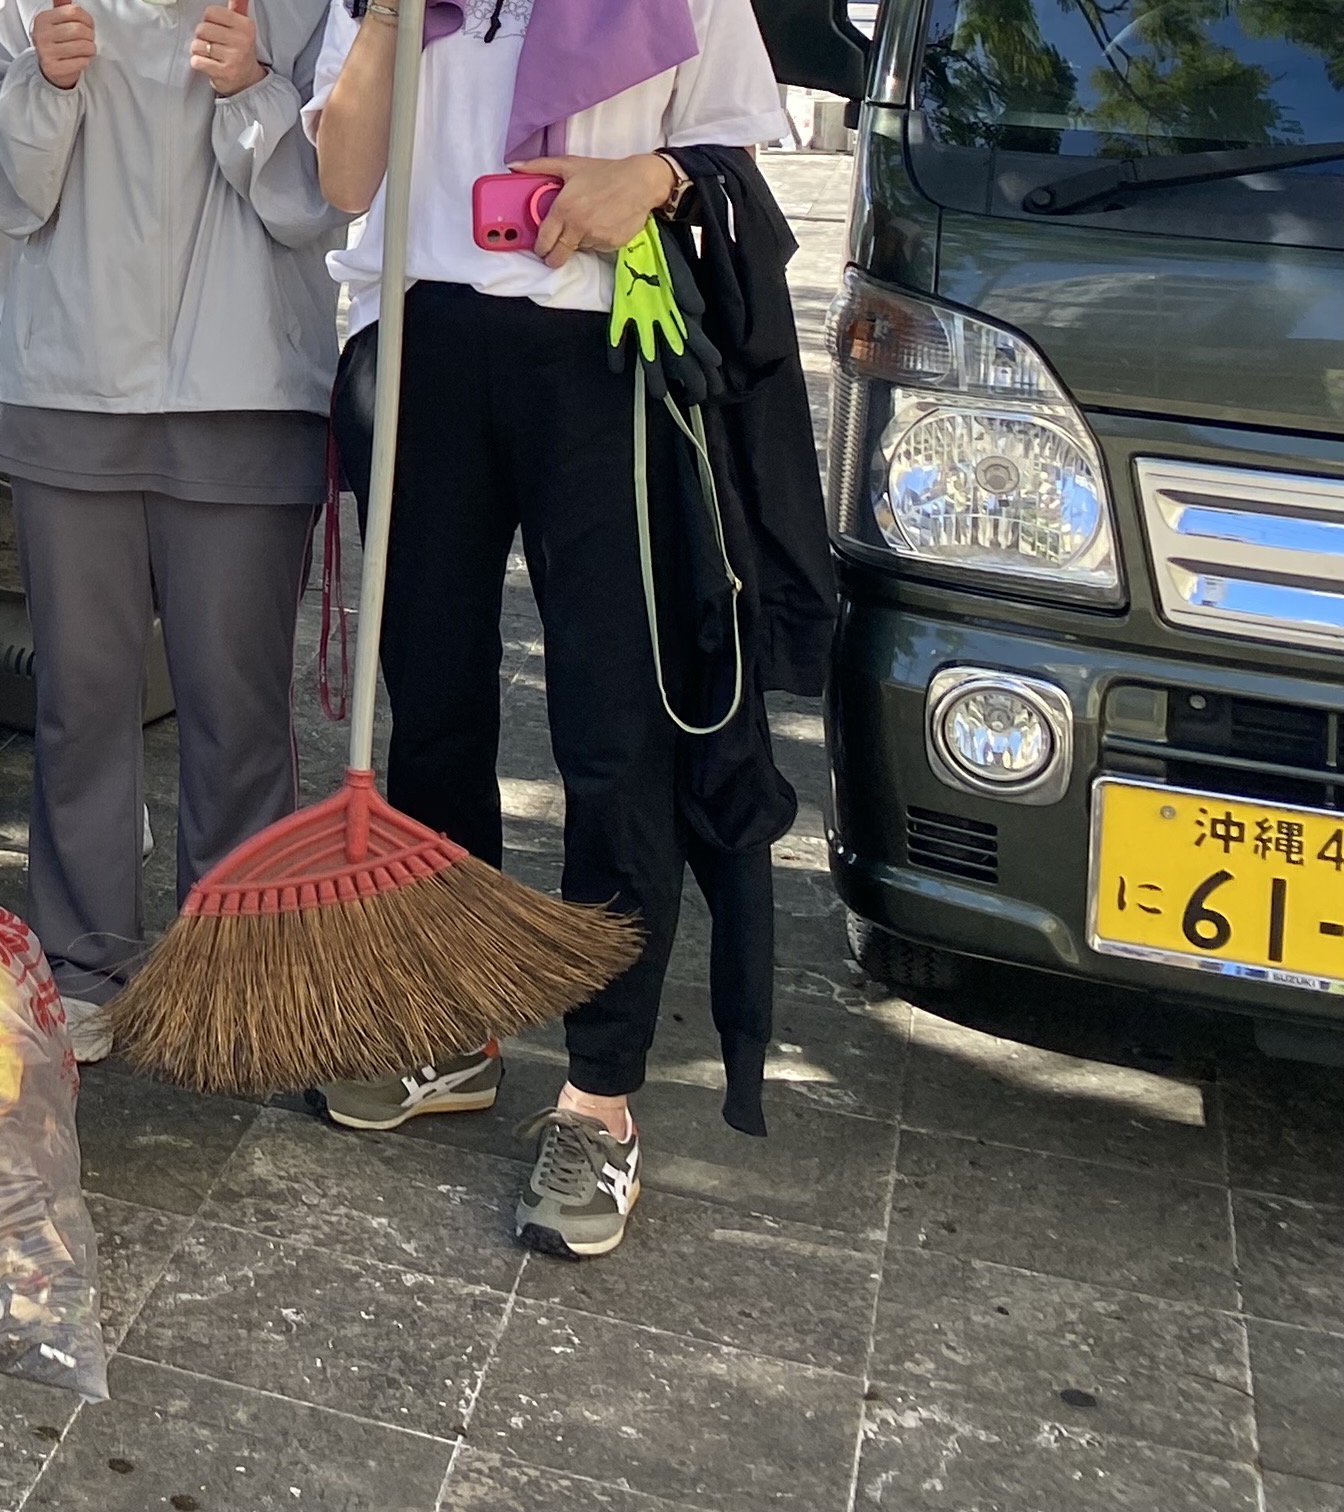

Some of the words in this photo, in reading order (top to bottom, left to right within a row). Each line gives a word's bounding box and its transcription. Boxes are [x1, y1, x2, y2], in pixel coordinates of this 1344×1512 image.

[1194, 807, 1305, 867] 沖縄
[1117, 875, 1163, 915] に
[1272, 972, 1316, 988] SUZUKI
